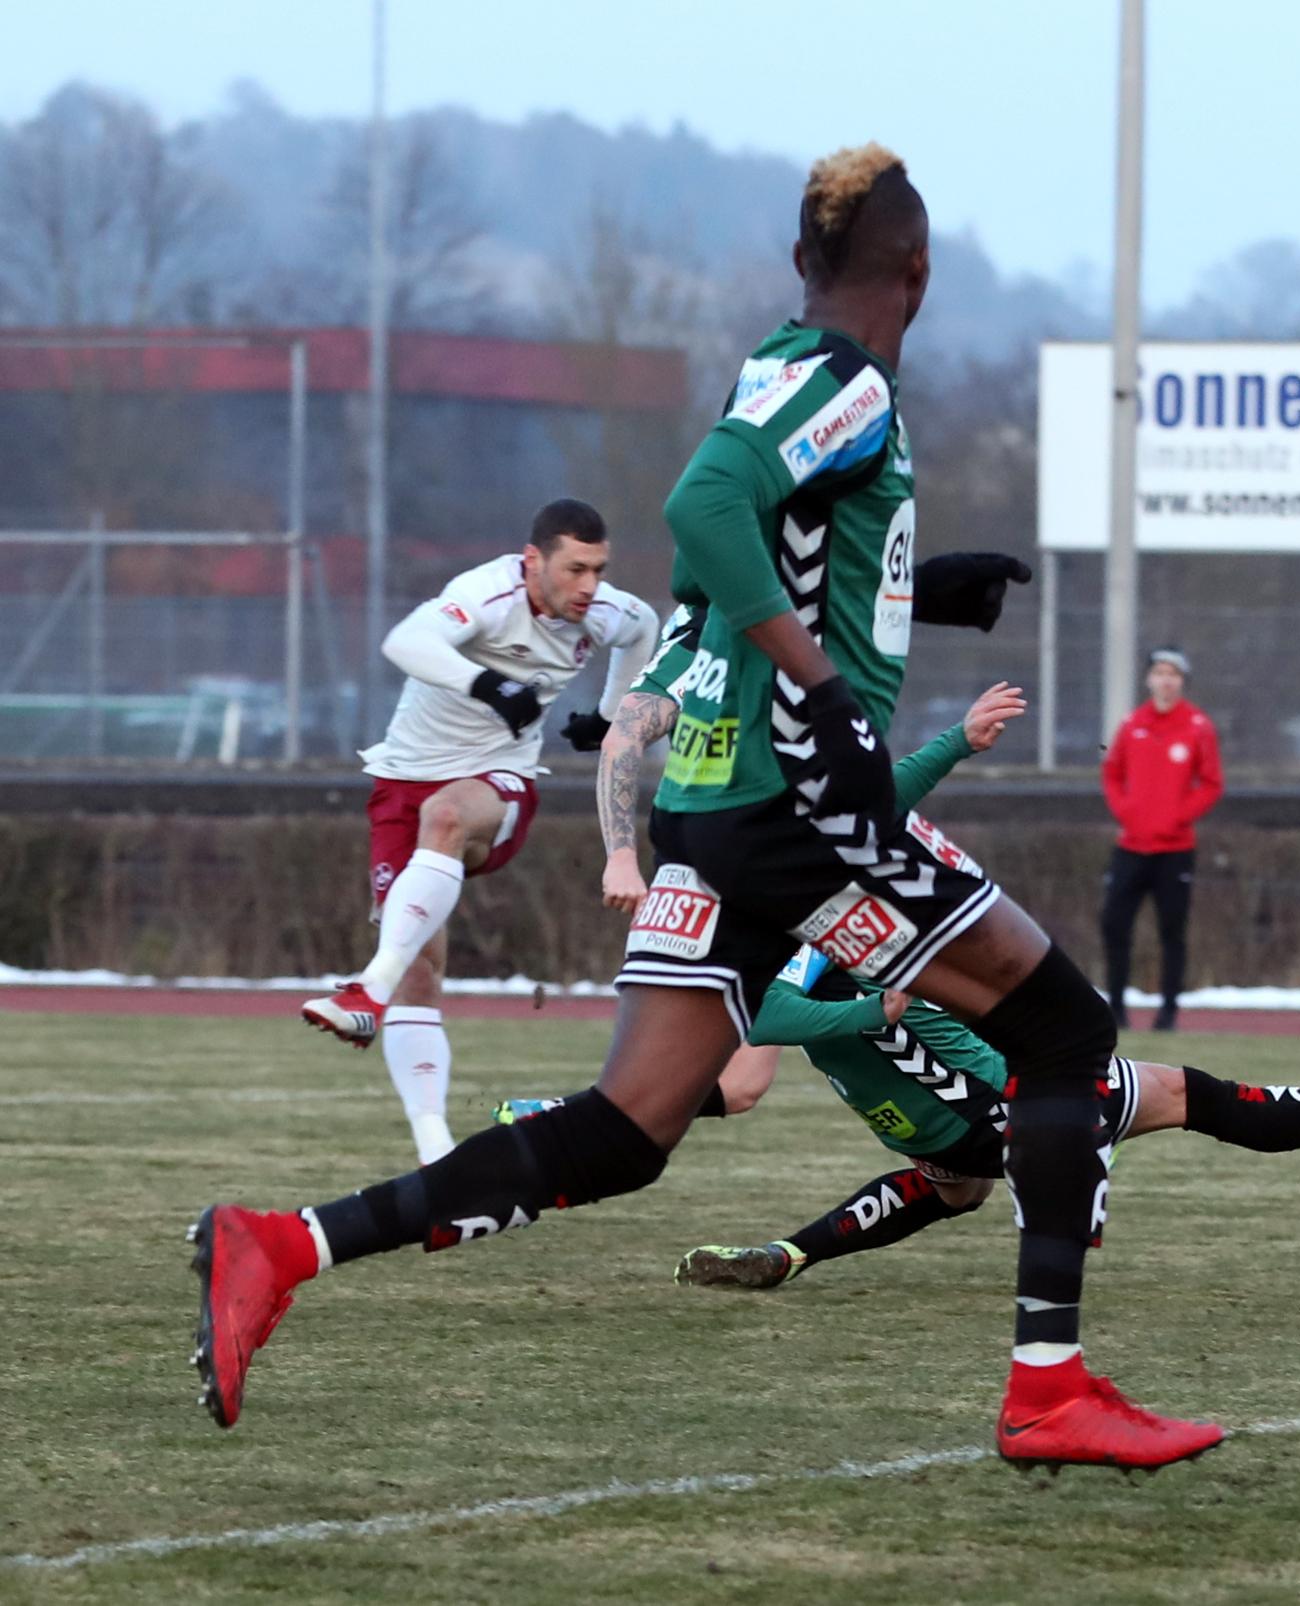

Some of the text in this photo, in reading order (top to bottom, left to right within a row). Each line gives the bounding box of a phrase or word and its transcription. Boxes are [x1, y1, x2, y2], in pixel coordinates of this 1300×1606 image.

[634, 890, 711, 934] BAST
[645, 932, 699, 956] Polling
[865, 930, 909, 969] Polling
